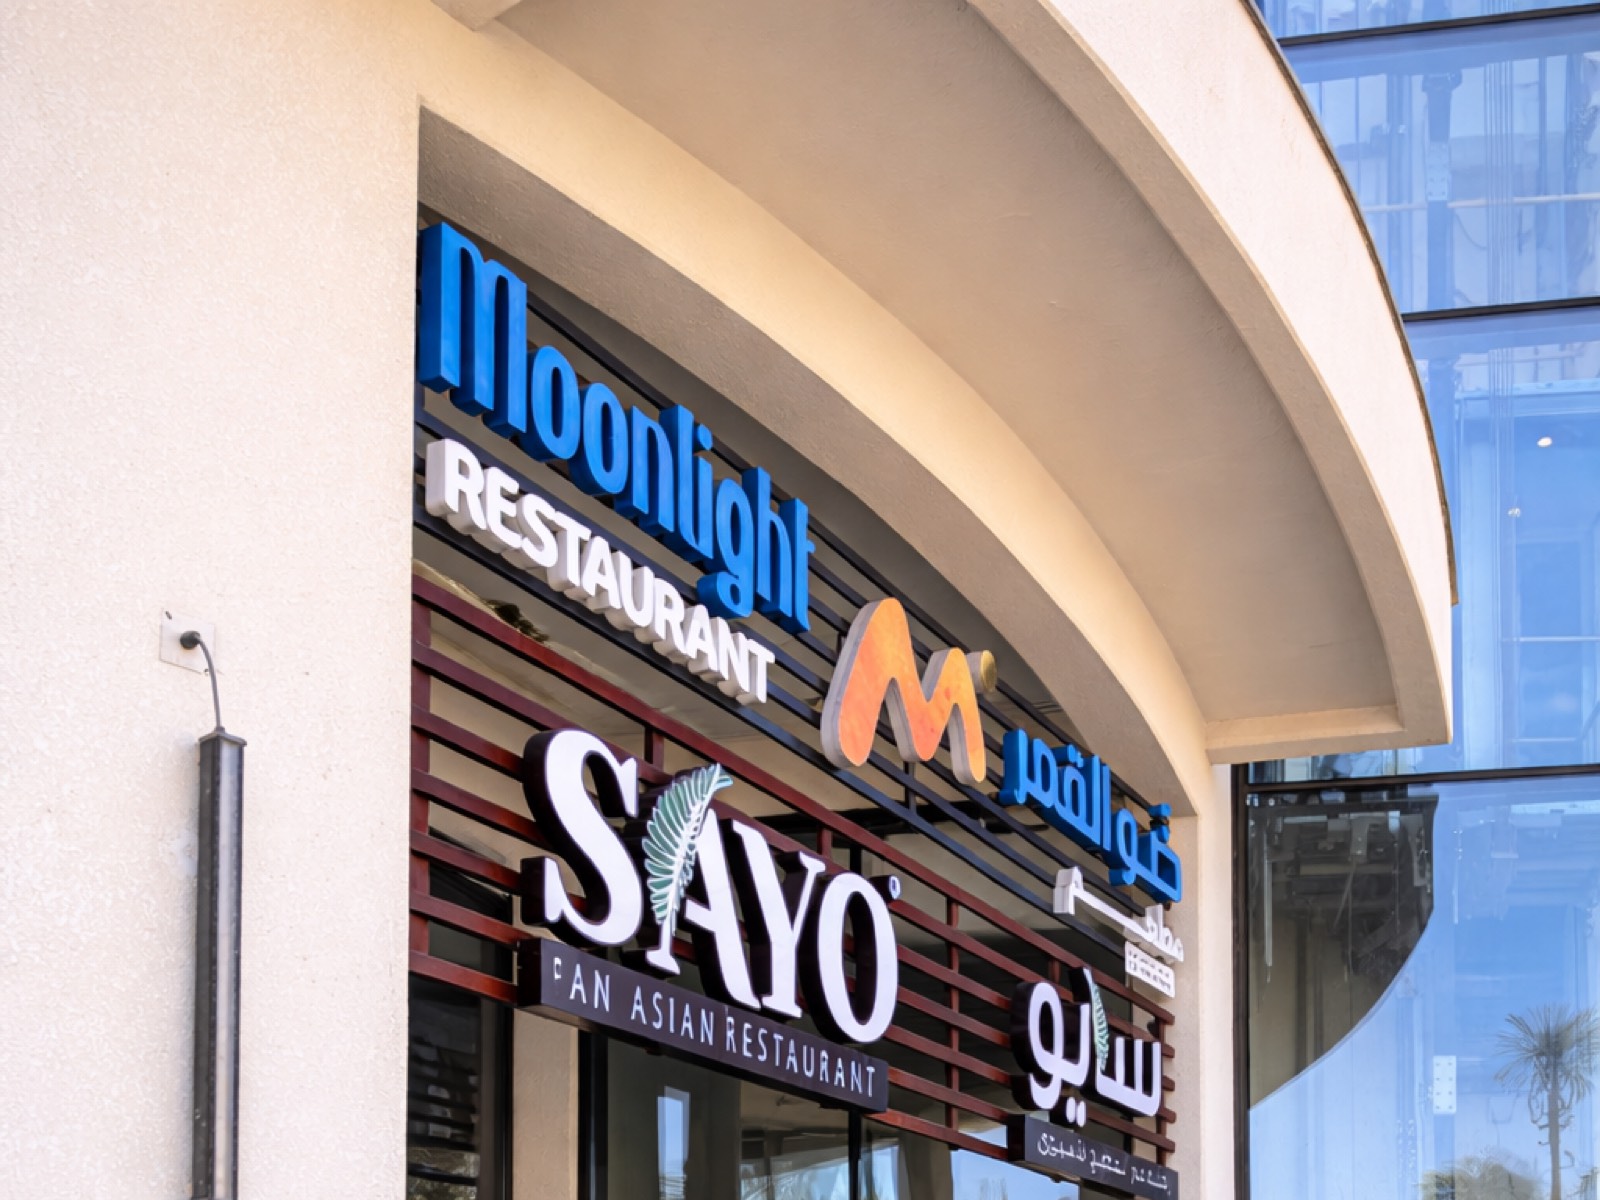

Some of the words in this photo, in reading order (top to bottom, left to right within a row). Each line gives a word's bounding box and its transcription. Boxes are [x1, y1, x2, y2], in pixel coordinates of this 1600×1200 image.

[425, 438, 775, 705] RESTAURANT
[630, 985, 715, 1046] ASIAN
[725, 1016, 875, 1098] RESTAURANT
